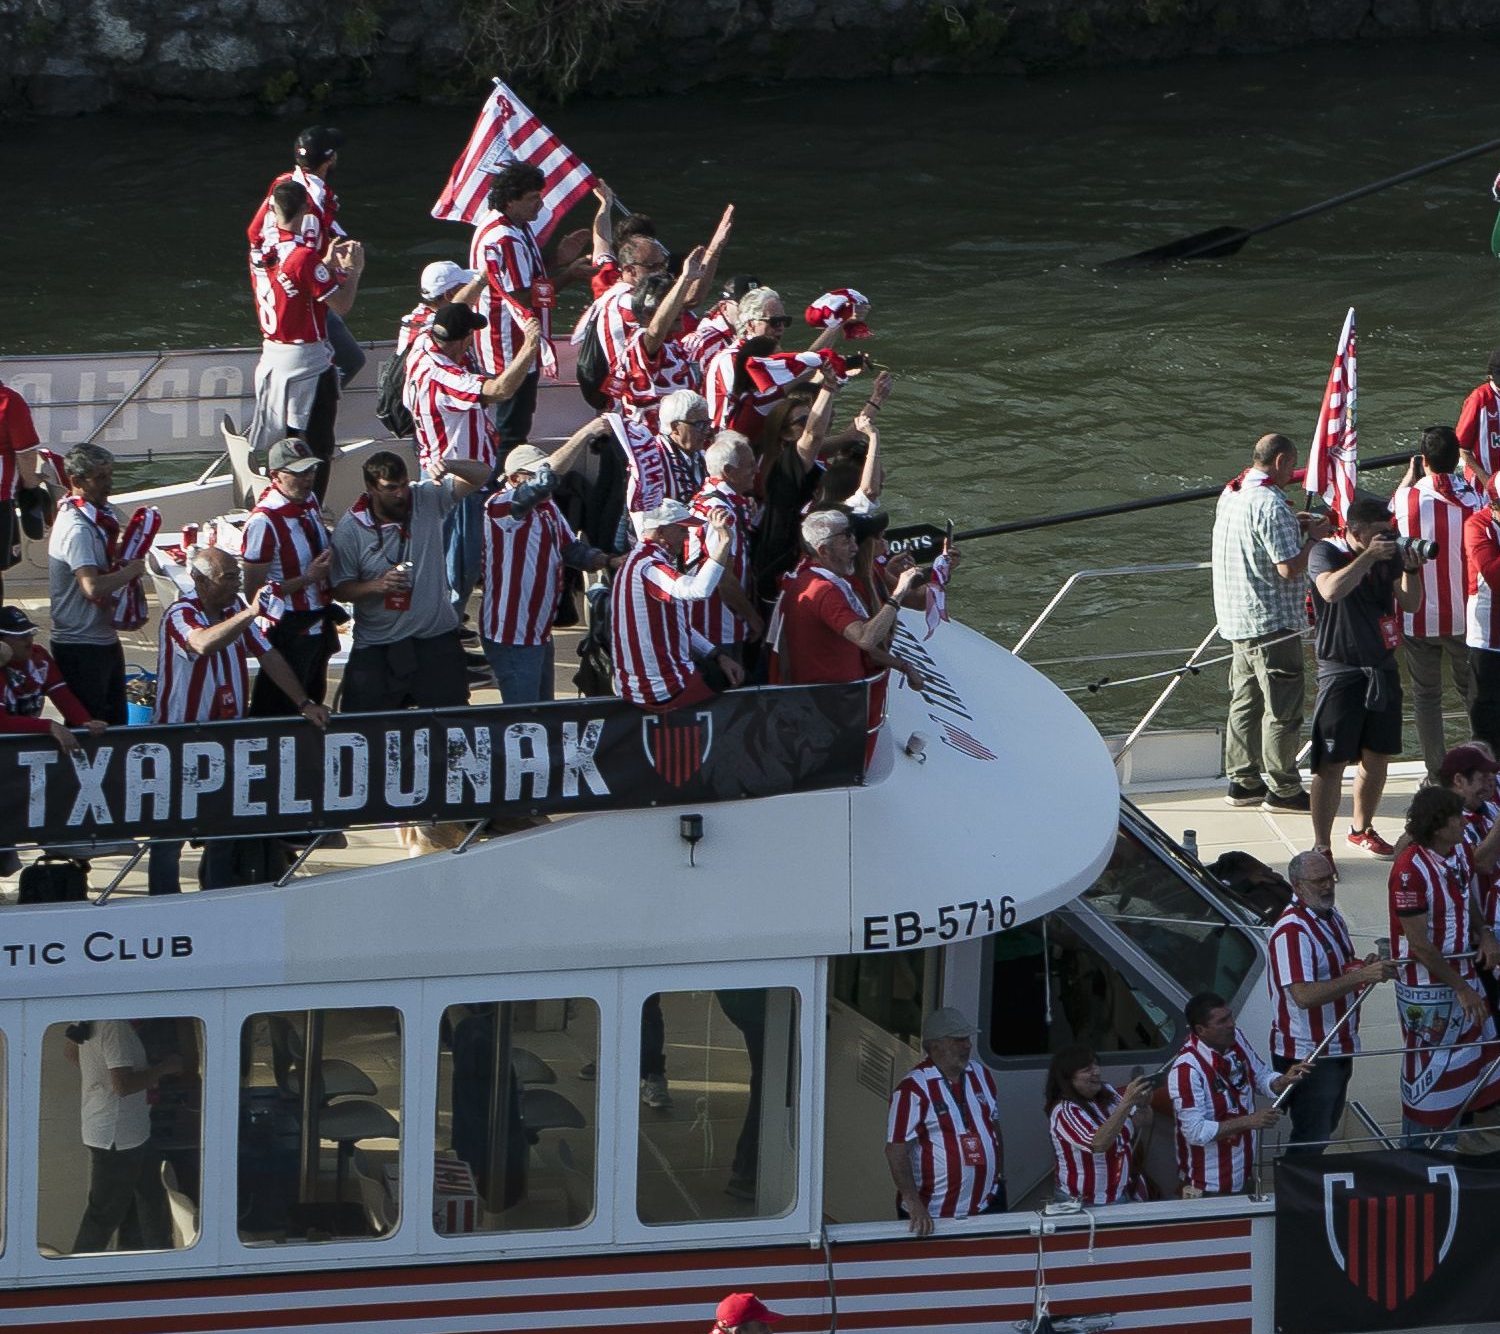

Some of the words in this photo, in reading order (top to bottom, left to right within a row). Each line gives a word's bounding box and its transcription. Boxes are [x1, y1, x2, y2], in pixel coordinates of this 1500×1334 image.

[889, 534, 933, 554] OATS
[26, 717, 610, 829] TXAPELDUNAK
[862, 894, 1017, 951] EB-5716
